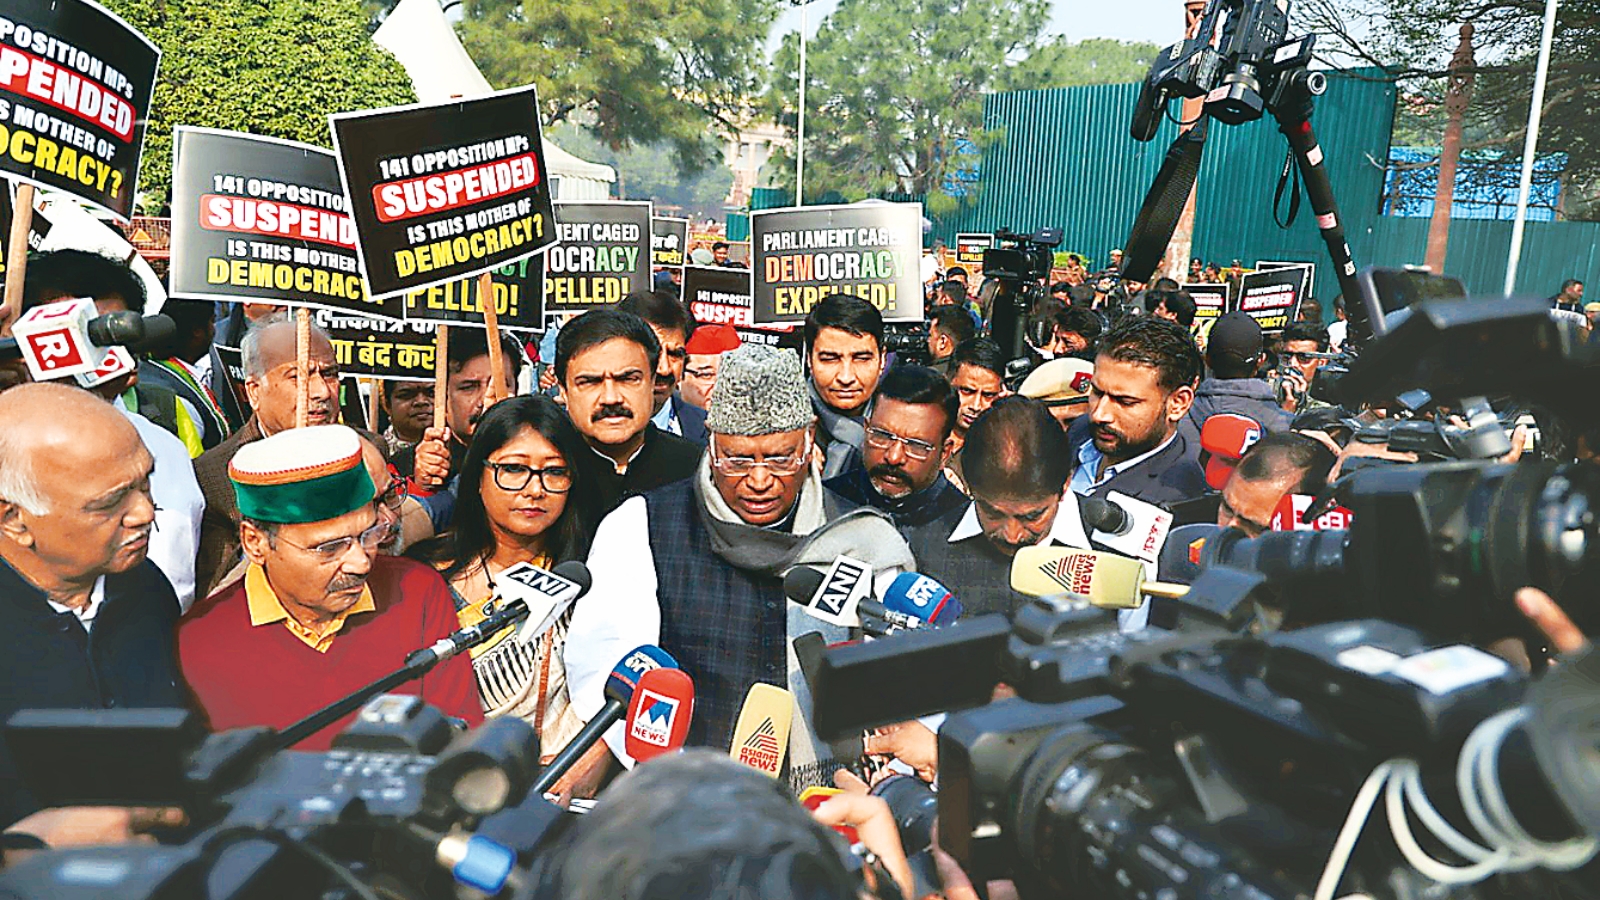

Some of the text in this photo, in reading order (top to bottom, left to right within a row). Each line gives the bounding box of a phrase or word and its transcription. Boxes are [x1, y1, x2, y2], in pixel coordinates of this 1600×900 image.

[13, 104, 97, 153] MOTHER
[97, 139, 115, 161] OF
[380, 156, 409, 180] 141
[412, 141, 504, 174] OPPOSITION
[213, 174, 243, 195] 141
[381, 156, 535, 218] SUSPENDED
[407, 198, 532, 245] IS THIS MOTHER OF
[592, 224, 640, 242] CAGED
[227, 239, 356, 273] IS THIS MOTHER
[395, 213, 544, 278] DEMOCRACY?
[763, 228, 856, 252] PARLIAMENT
[547, 246, 639, 273] OCRACY
[765, 250, 906, 284] DEMOCRACY
[509, 569, 568, 595] ANI
[820, 563, 862, 614] ANI
[1080, 554, 1097, 595] news
[634, 727, 666, 743] NEWS
[740, 753, 778, 772] news
